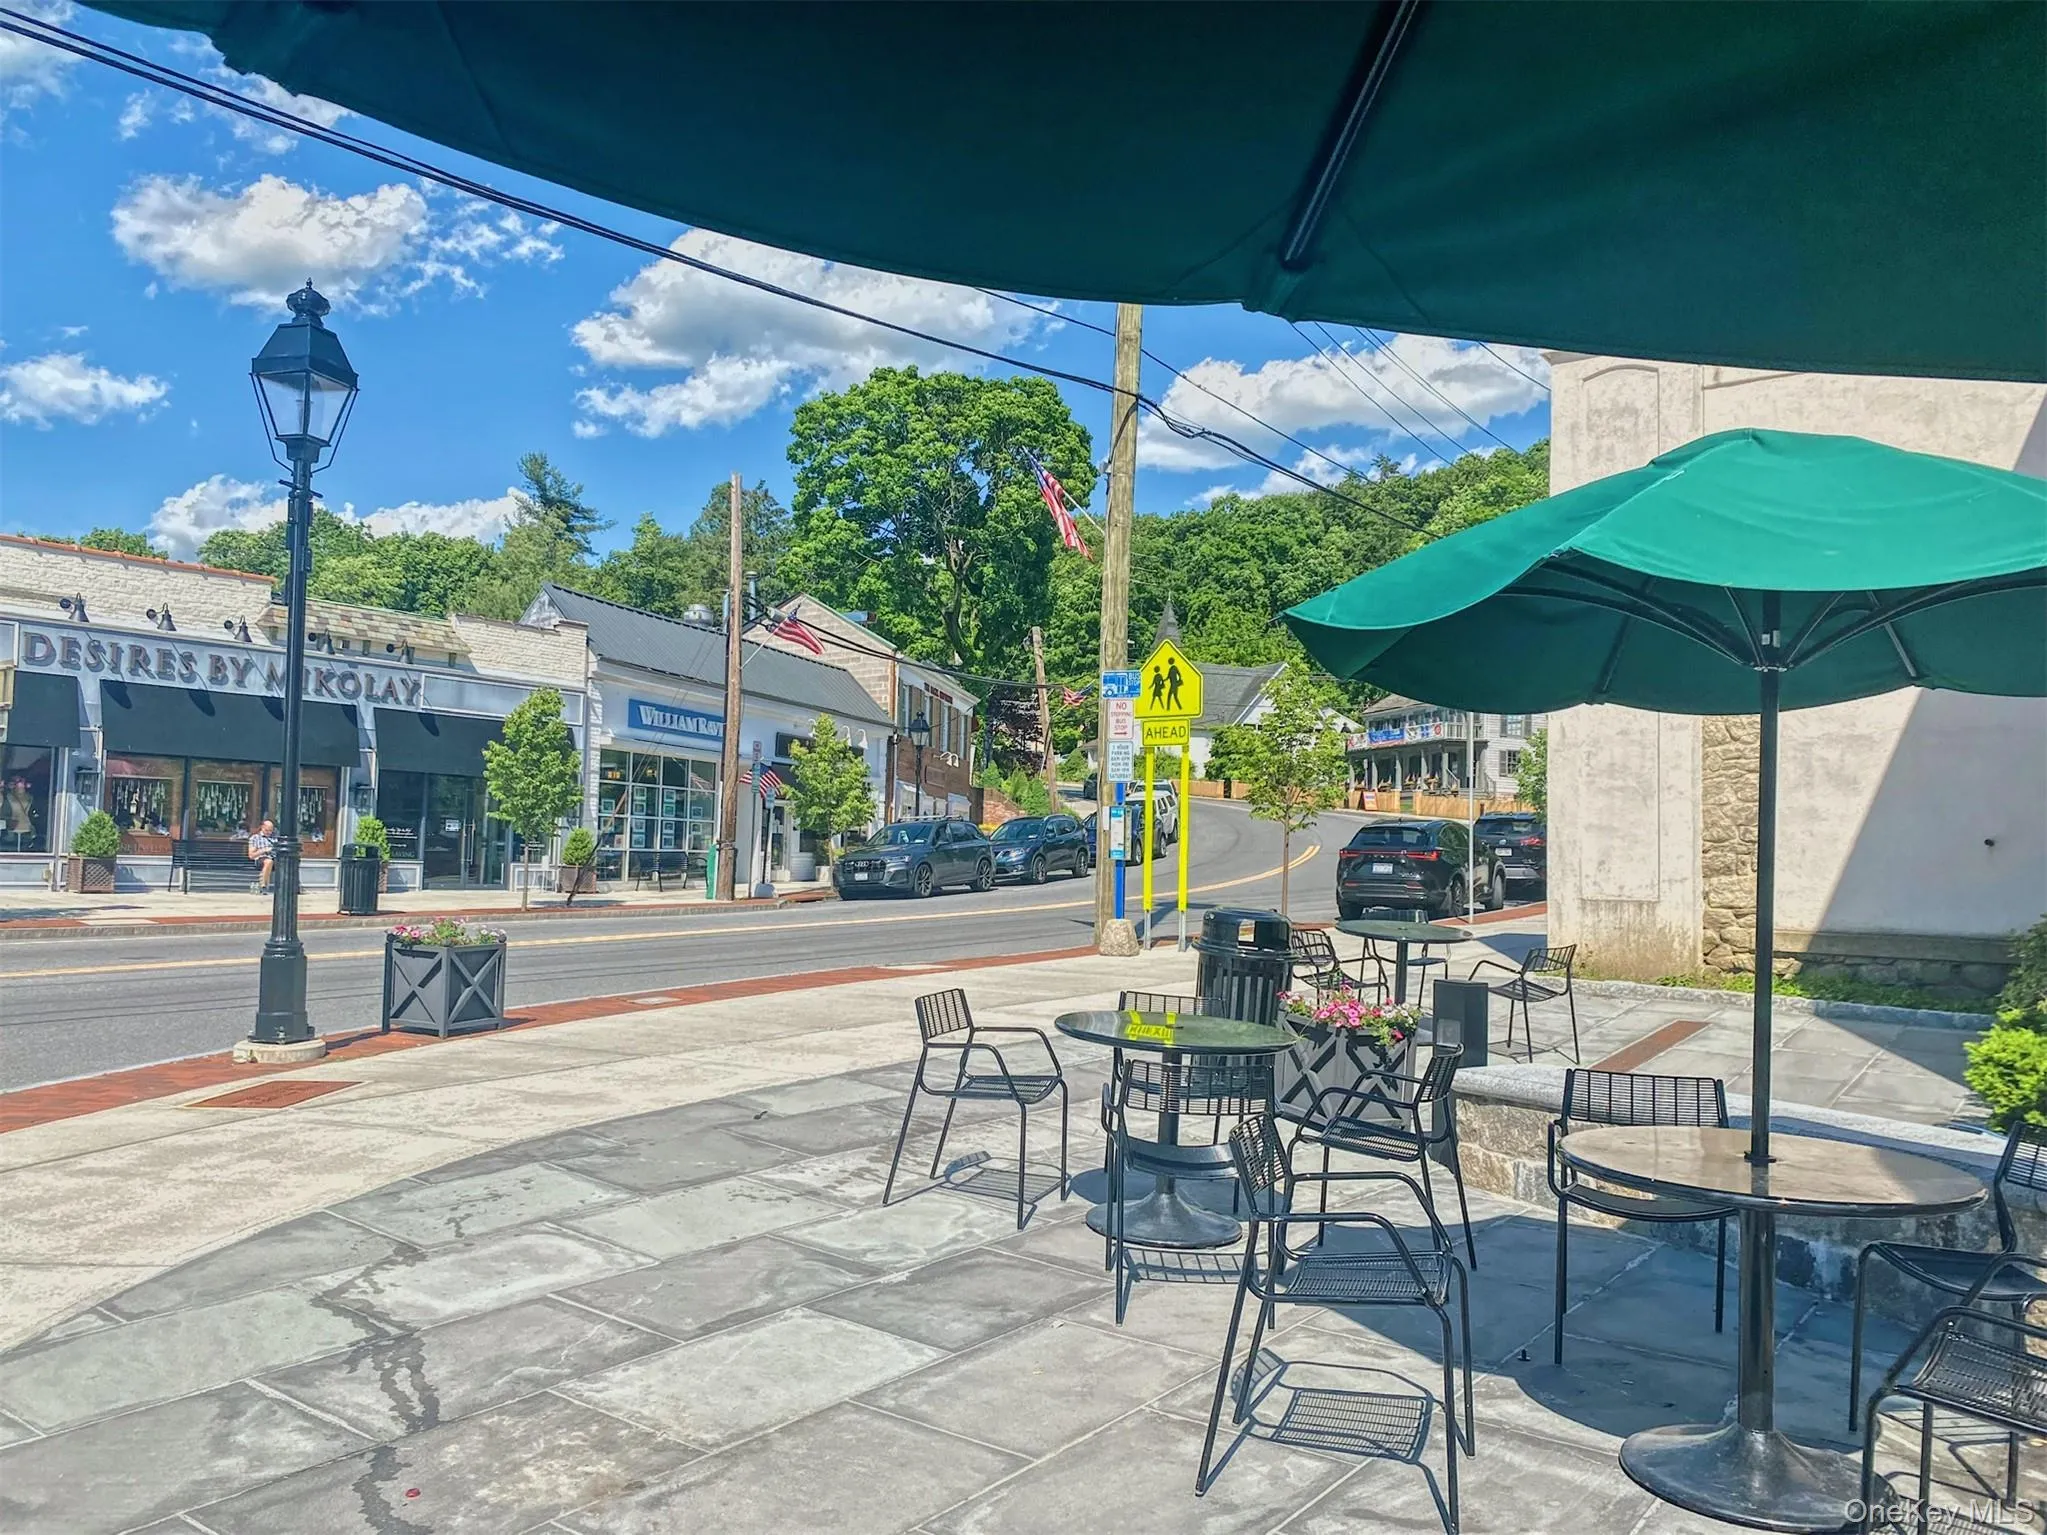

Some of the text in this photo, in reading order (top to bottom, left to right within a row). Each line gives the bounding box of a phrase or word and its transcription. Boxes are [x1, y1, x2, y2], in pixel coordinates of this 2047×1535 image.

[22, 631, 422, 706] DESIRES BY MIKOLAY
[1115, 702, 1127, 710] NO
[638, 704, 698, 732] WILLIAM
[1145, 725, 1187, 739] AHEAD
